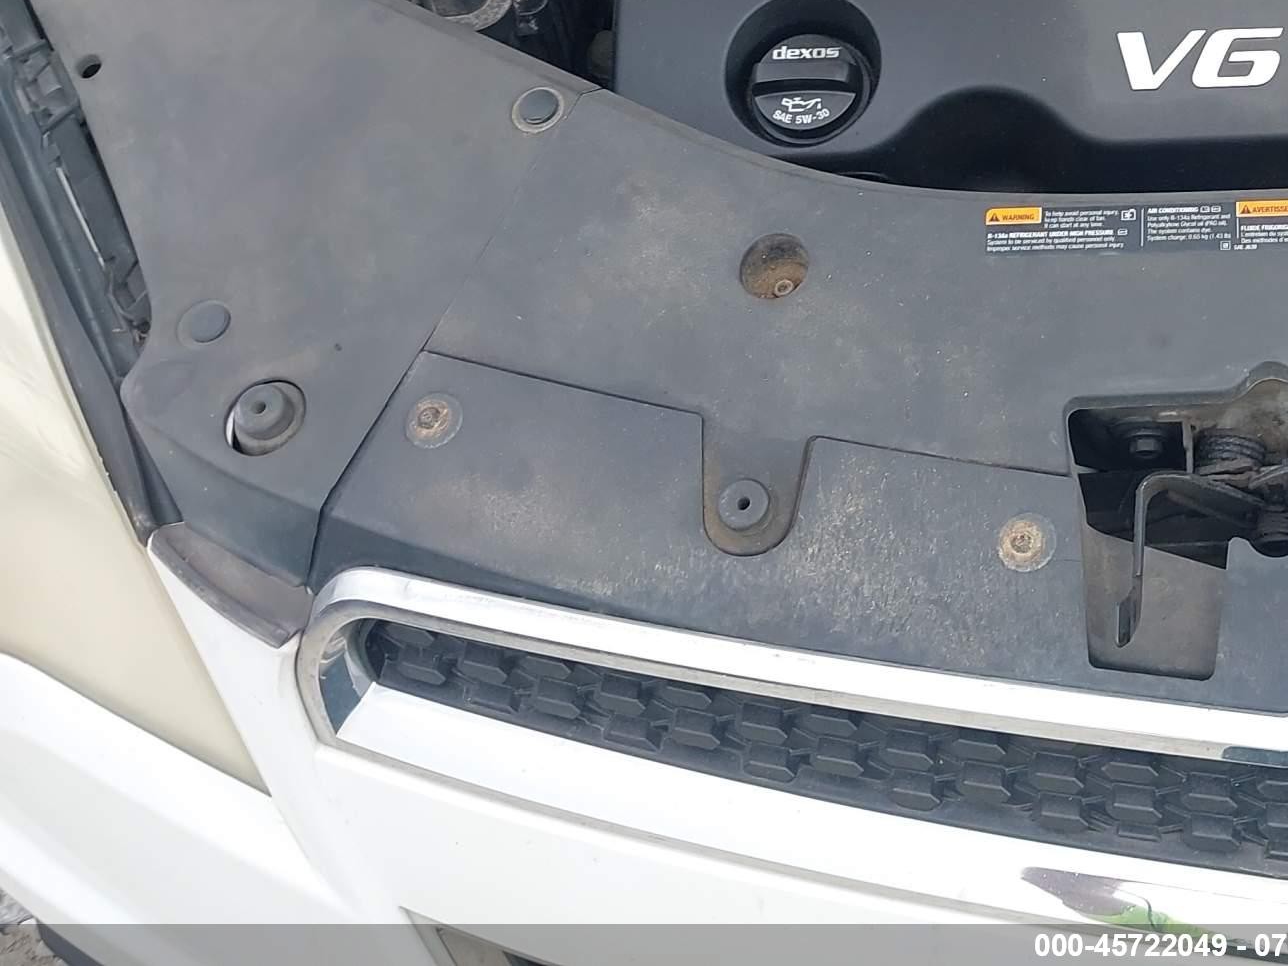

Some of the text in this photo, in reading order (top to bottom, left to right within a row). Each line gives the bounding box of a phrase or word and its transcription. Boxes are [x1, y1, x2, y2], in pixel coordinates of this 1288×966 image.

[772, 45, 842, 60] dexos
[1116, 26, 1284, 91] V6
[772, 108, 830, 124] SAE 5W-30
[1002, 213, 1036, 221] WARNING
